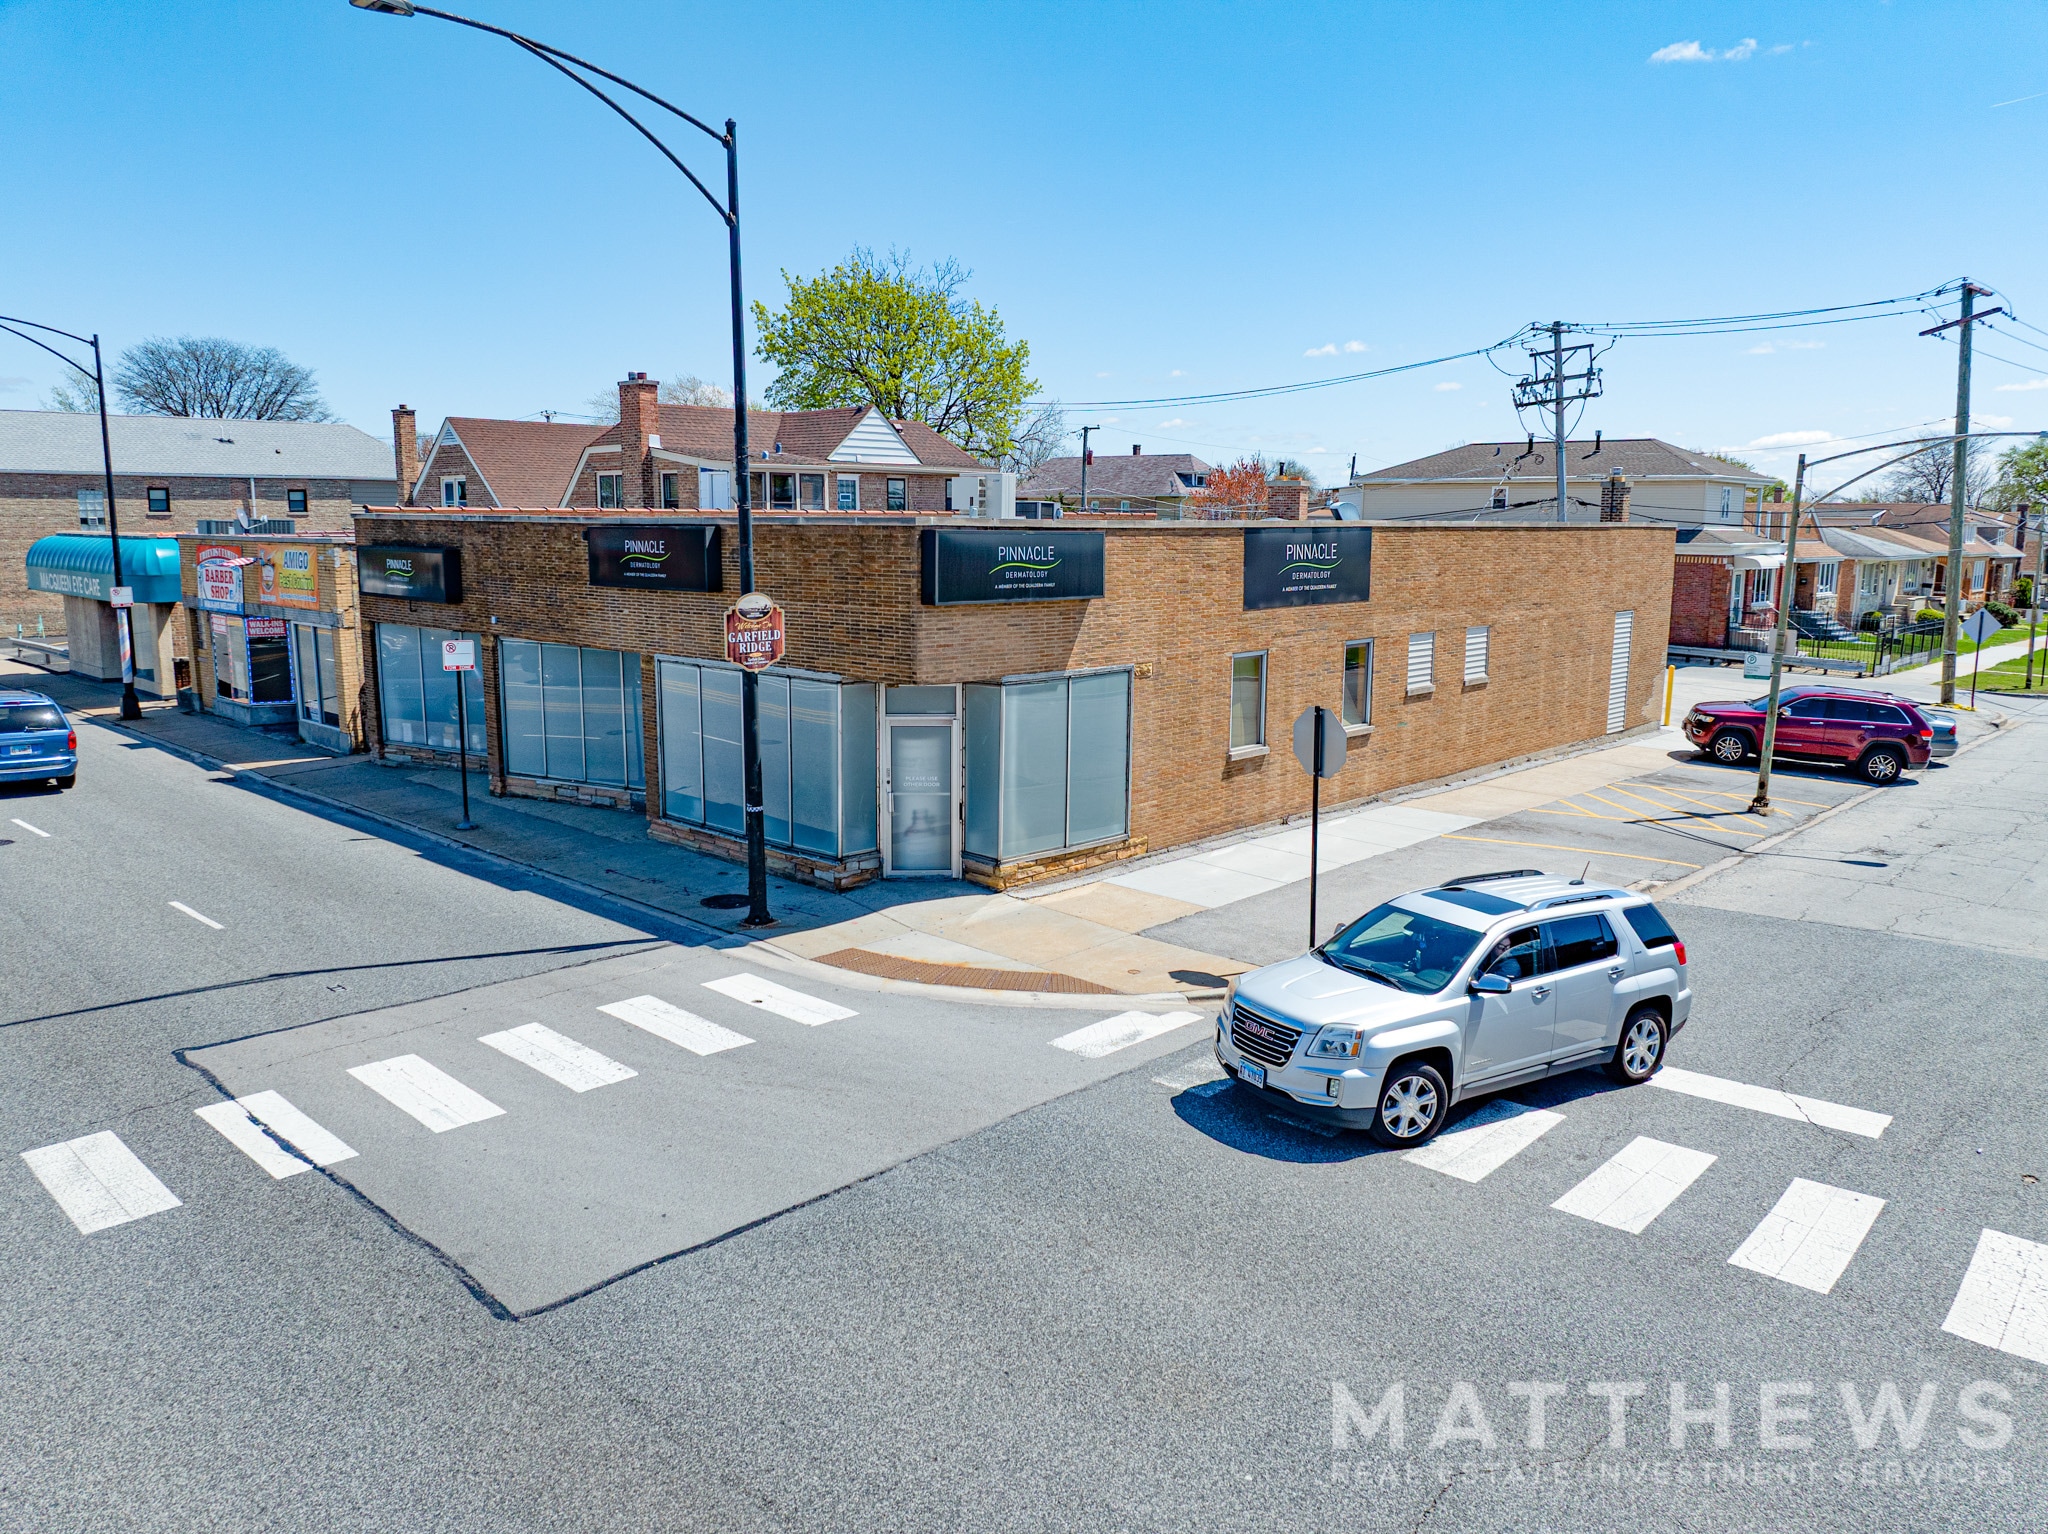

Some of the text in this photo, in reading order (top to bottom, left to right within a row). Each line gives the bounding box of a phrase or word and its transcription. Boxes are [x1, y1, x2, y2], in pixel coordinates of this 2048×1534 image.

[624, 539, 665, 554] PINNACLE
[1286, 543, 1338, 560] PINNACLE
[998, 546, 1055, 561] PINNACLE
[282, 550, 309, 571] AMIGO
[386, 558, 413, 571] PINNACLE
[629, 561, 661, 569] DERMATOLOGY
[205, 568, 235, 585] BARBER
[1005, 570, 1048, 579] DERMATOLOGY
[1292, 571, 1331, 580] DERMATOLOGY
[39, 571, 101, 597] MACQUEEN EYE CARE
[211, 585, 230, 600] SHOP
[249, 620, 284, 628] WALK-INS
[735, 621, 761, 631] Welcome
[249, 627, 285, 635] WELCOME
[728, 630, 781, 643] GARFIELD
[739, 641, 772, 654] RIDGE
[1245, 1019, 1275, 1041] GMC
